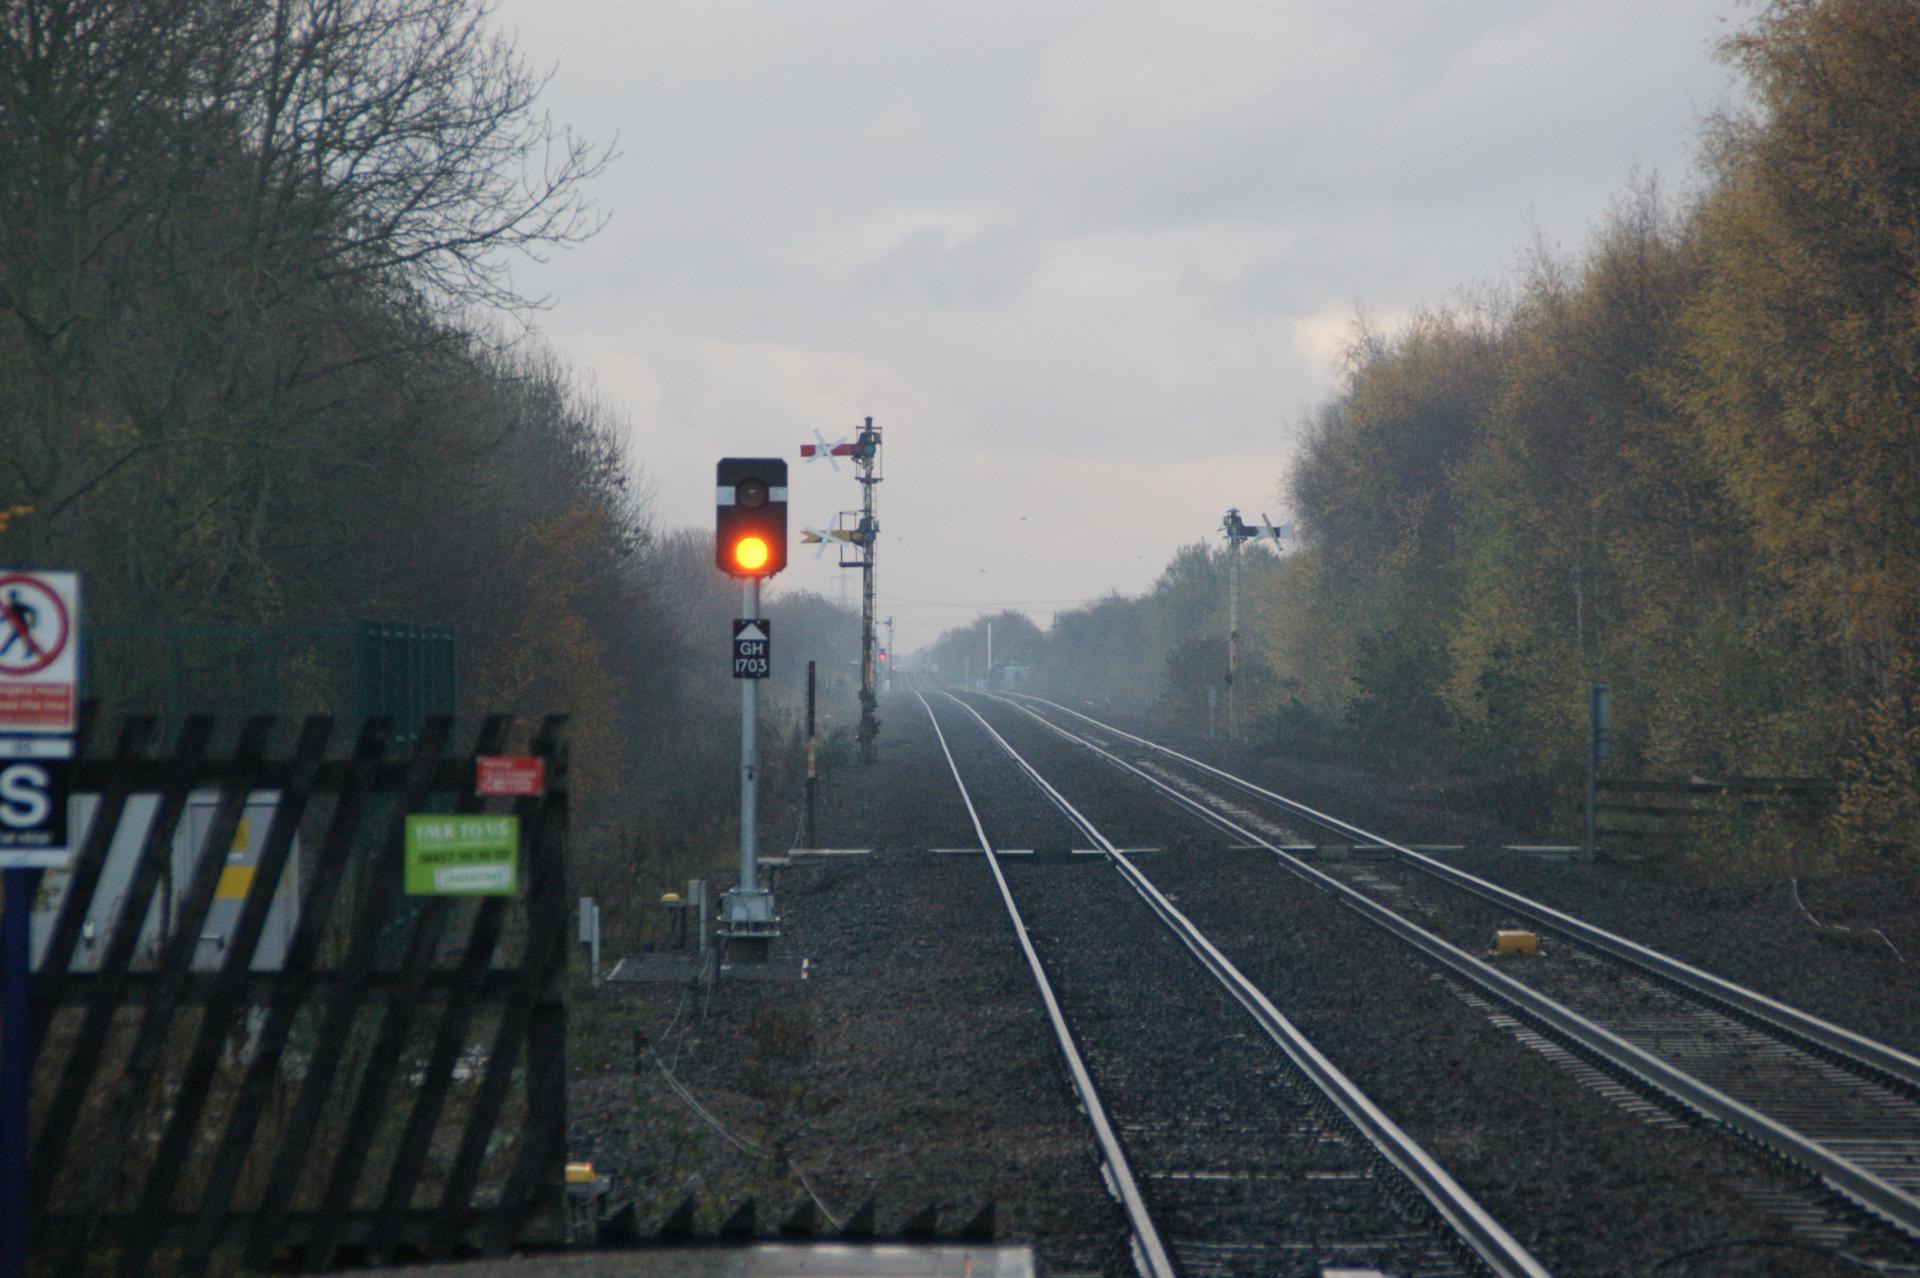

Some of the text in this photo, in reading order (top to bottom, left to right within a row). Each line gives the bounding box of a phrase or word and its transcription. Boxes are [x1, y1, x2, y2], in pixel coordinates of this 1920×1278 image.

[740, 642, 763, 655] GH
[735, 658, 767, 673] 1703
[0, 764, 48, 828] S
[415, 818, 509, 841] TALK TO US
